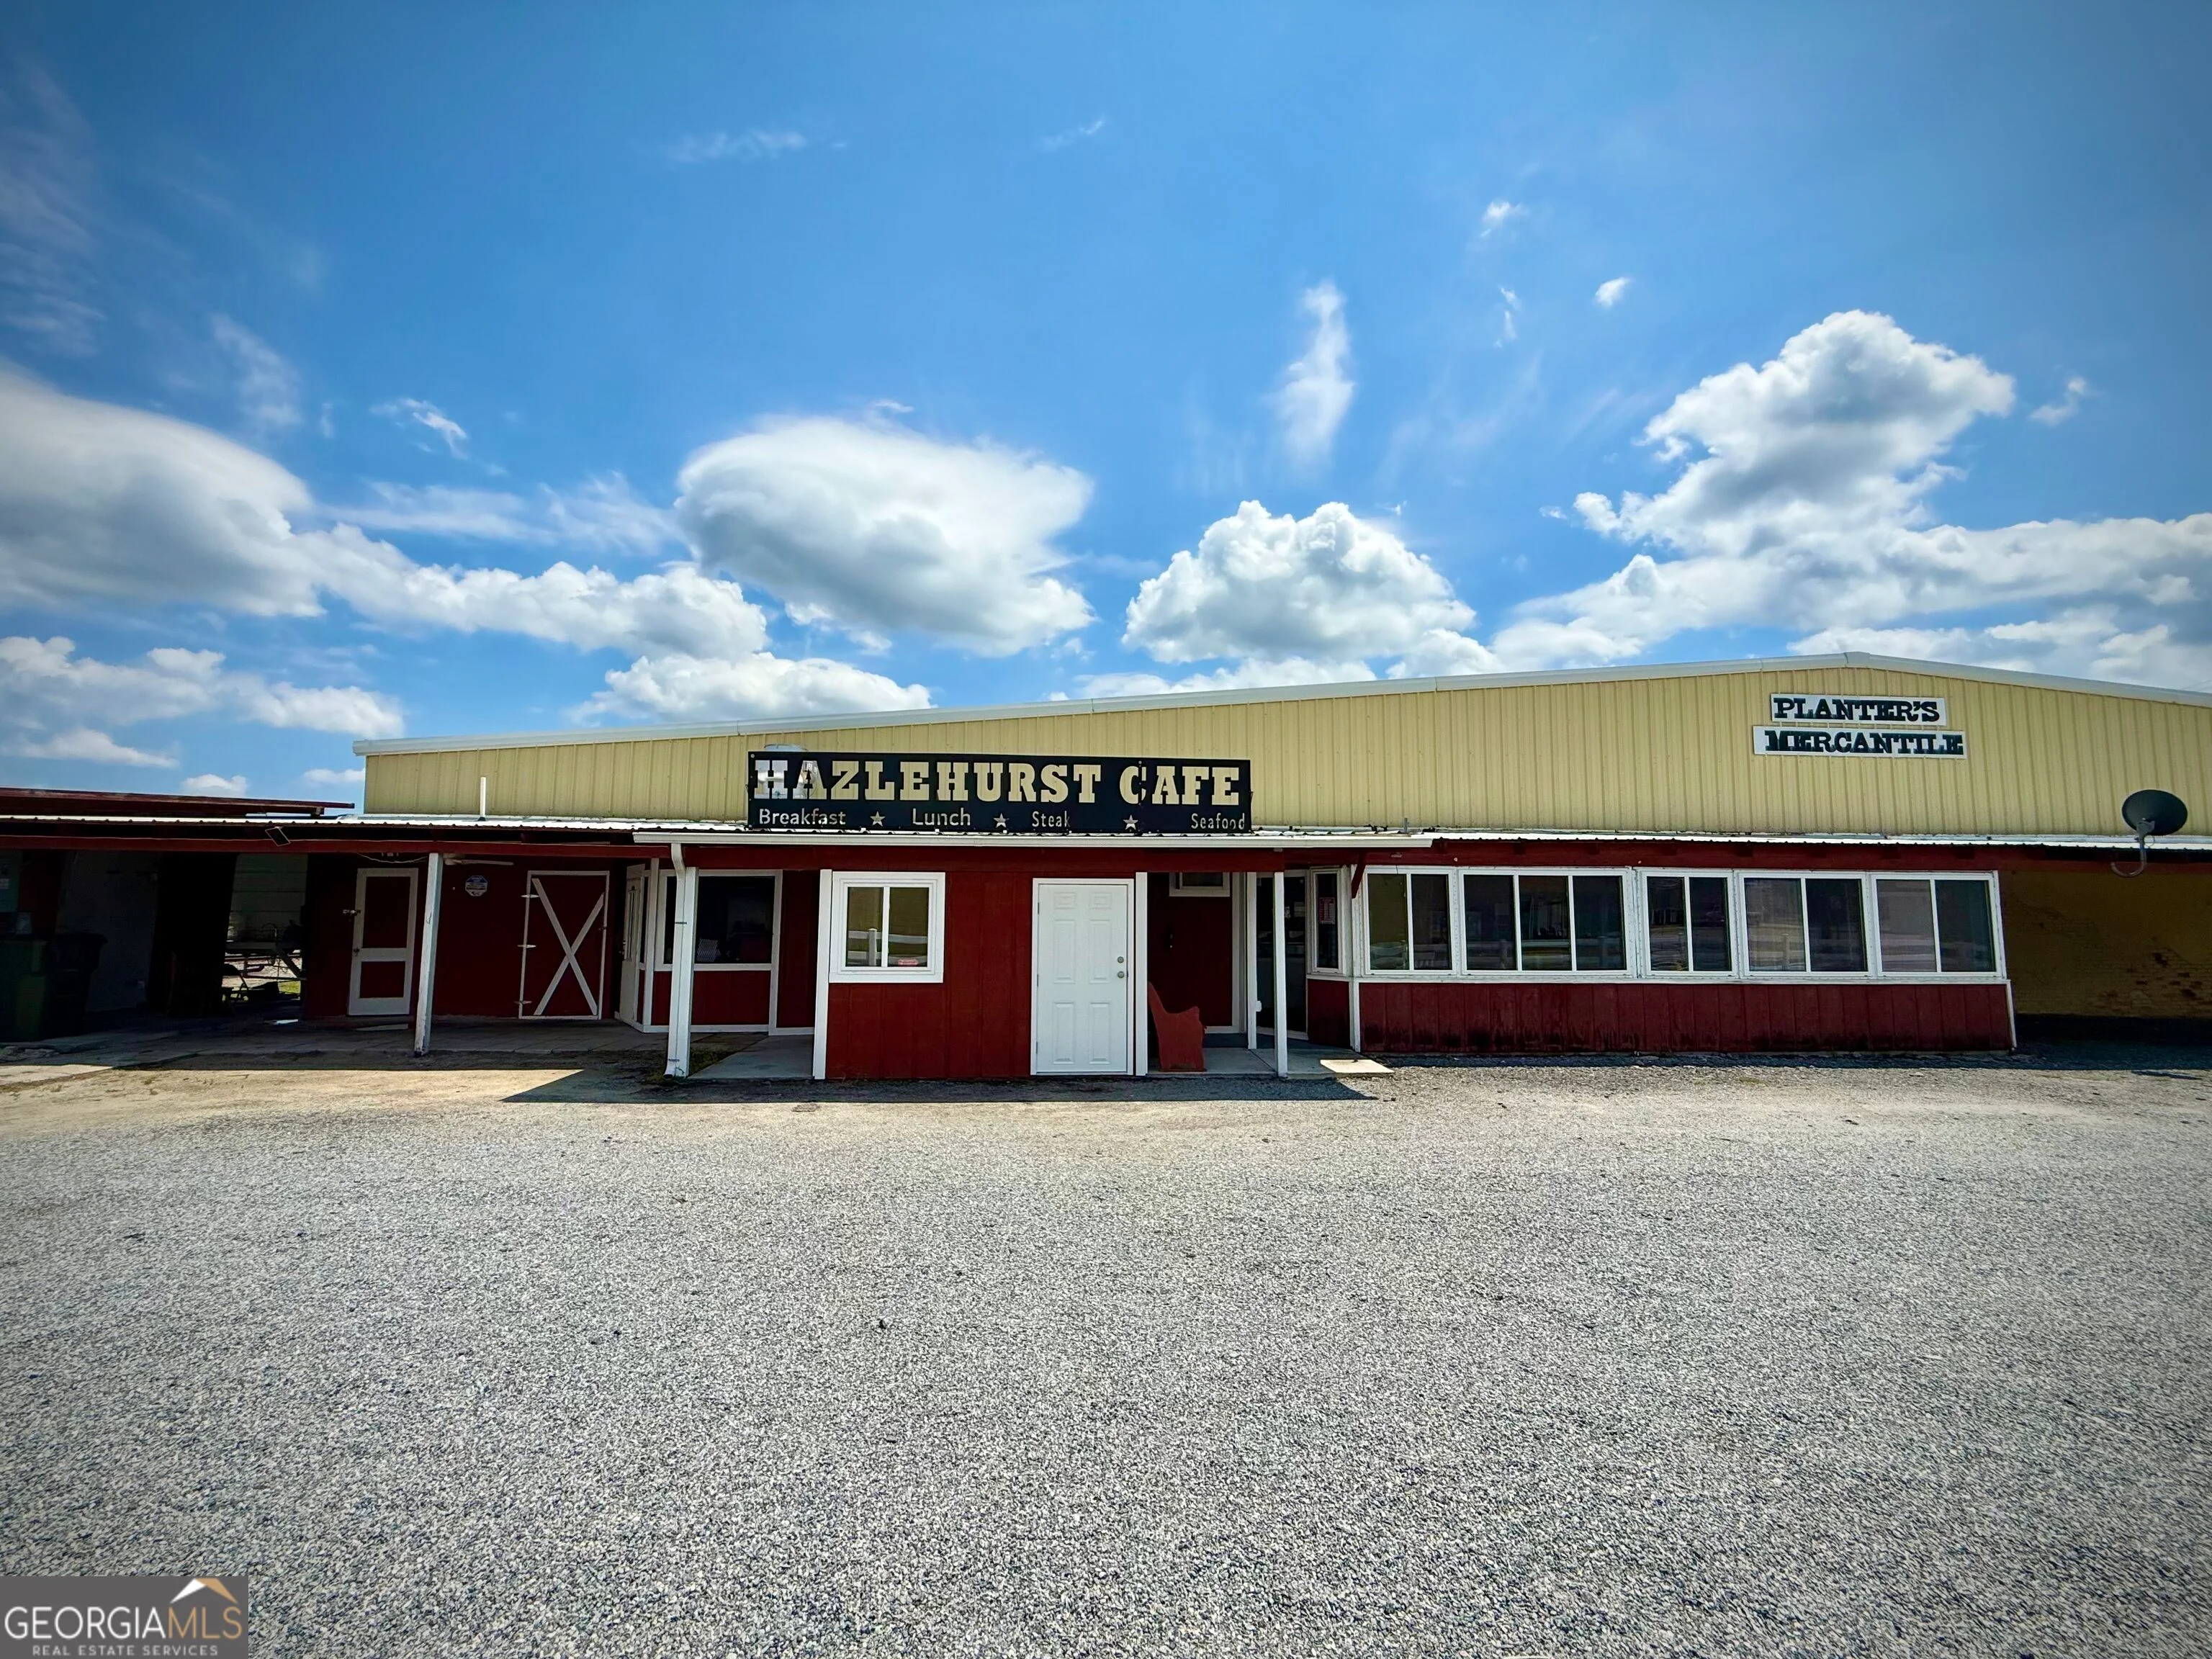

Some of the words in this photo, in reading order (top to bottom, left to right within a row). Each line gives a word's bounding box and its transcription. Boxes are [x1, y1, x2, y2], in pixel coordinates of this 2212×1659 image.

[1773, 697, 1941, 722] PLANTER'S
[1764, 729, 1964, 755] MERCANTILE
[754, 760, 1102, 804] HAZLEHURST
[1119, 765, 1240, 806] CAFE
[758, 807, 846, 826] Breakfast
[912, 807, 971, 827] Lunch
[1031, 811, 1070, 828] Steak
[1190, 812, 1245, 830] Seafood
